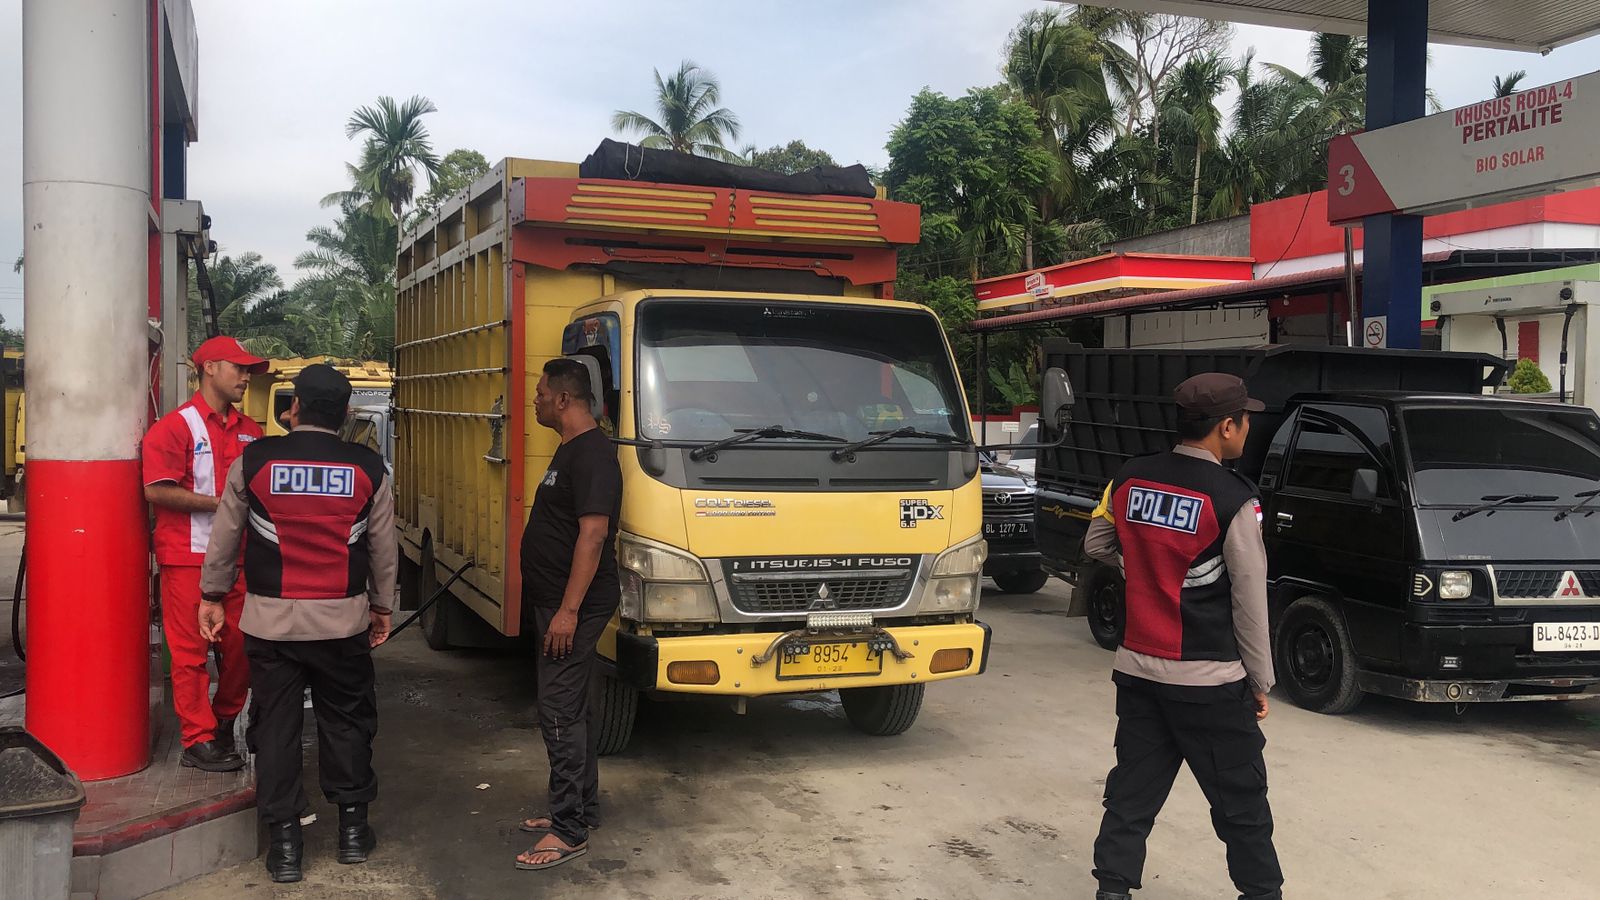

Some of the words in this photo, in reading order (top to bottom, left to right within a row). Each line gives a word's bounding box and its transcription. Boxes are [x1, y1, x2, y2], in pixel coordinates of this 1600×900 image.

[1455, 97, 1511, 126] KHUSUS
[1462, 103, 1562, 144] PERTALITE
[1476, 154, 1497, 173] BIO
[1502, 146, 1545, 168] SOLAR
[1337, 165, 1356, 196] 3
[273, 466, 352, 494] POLISI
[1128, 490, 1199, 530] POLISI
[900, 520, 917, 528] 6.6
[985, 523, 996, 534] BL
[999, 523, 1016, 533] 1277
[858, 557, 912, 567] FUSO
[813, 645, 850, 663] 8954
